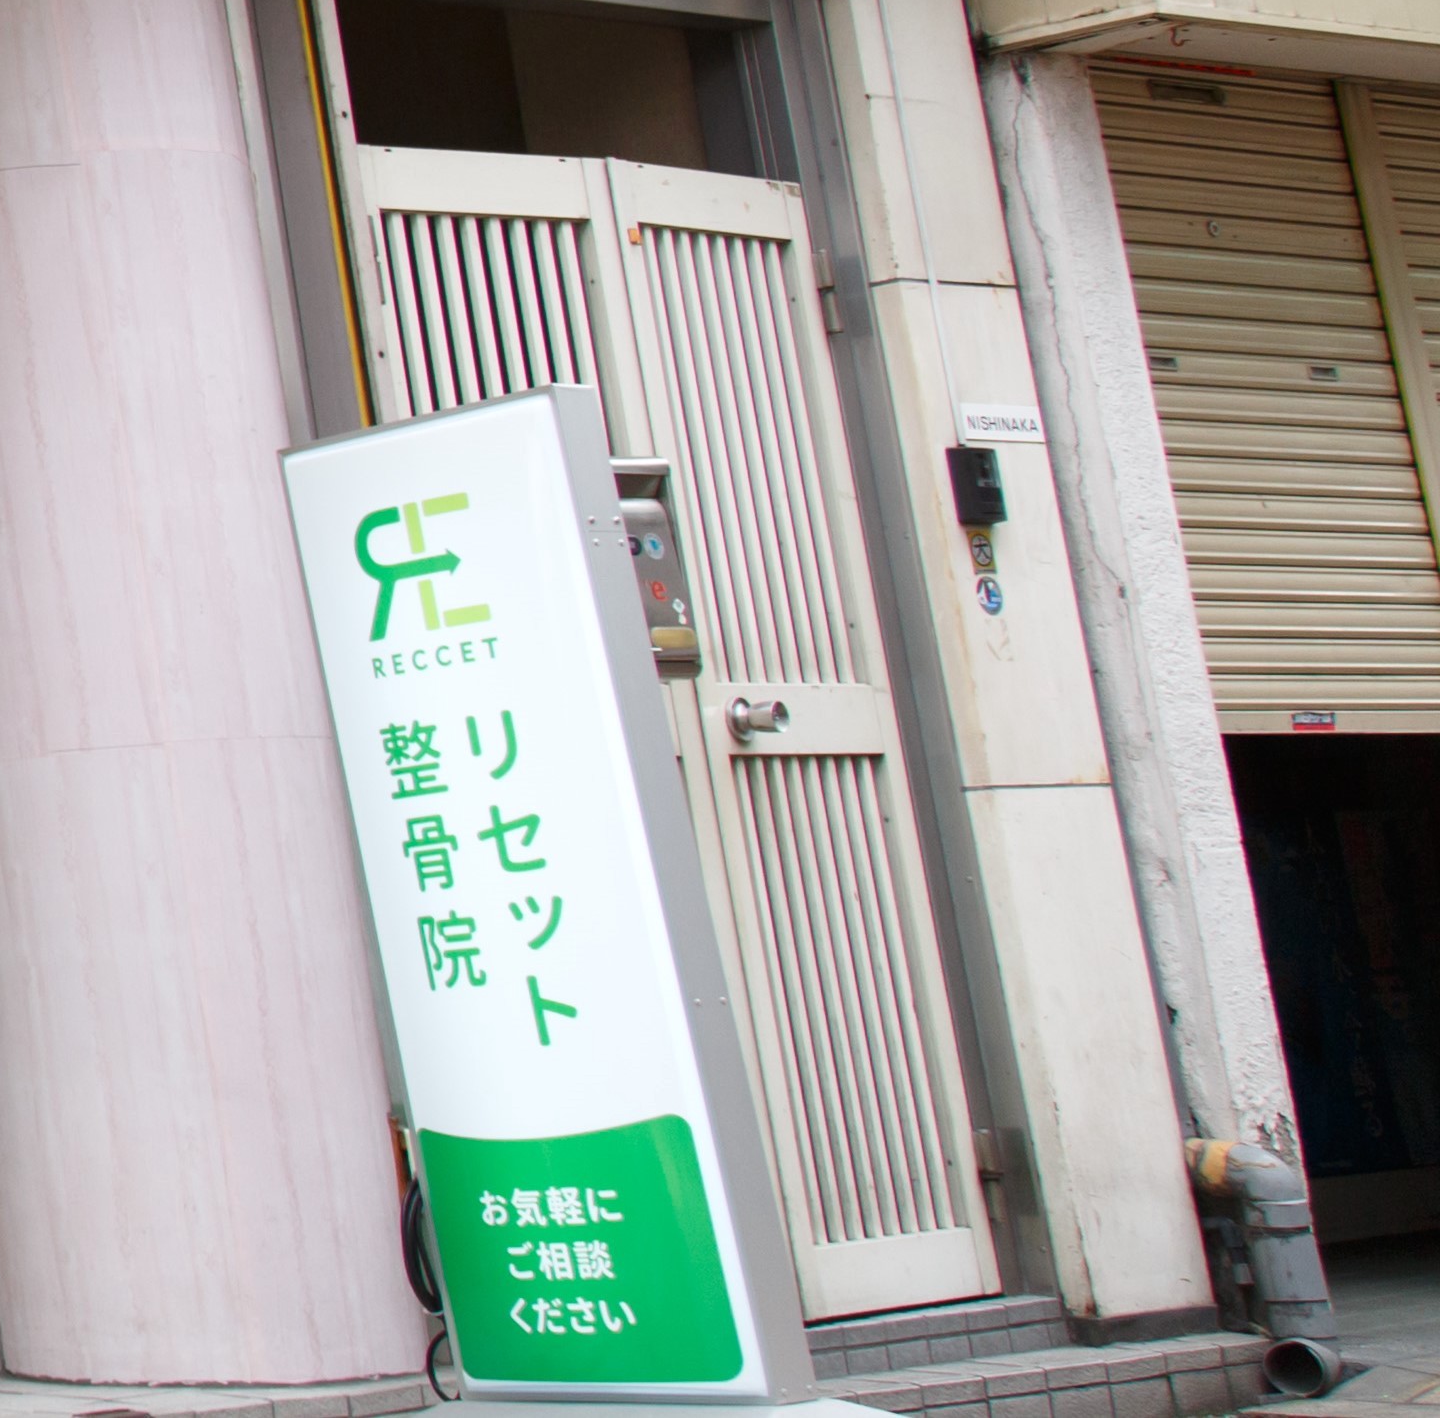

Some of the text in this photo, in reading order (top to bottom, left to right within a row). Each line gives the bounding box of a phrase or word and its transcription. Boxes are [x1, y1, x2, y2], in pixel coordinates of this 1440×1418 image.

[966, 414, 1040, 434] NISHINAKA
[372, 636, 501, 679] RECCET
[380, 720, 487, 991] 整骨院
[465, 709, 578, 1047] リセット
[479, 1185, 624, 1227] お気軽に
[506, 1240, 616, 1281] ご相談
[509, 1297, 637, 1335] ください
